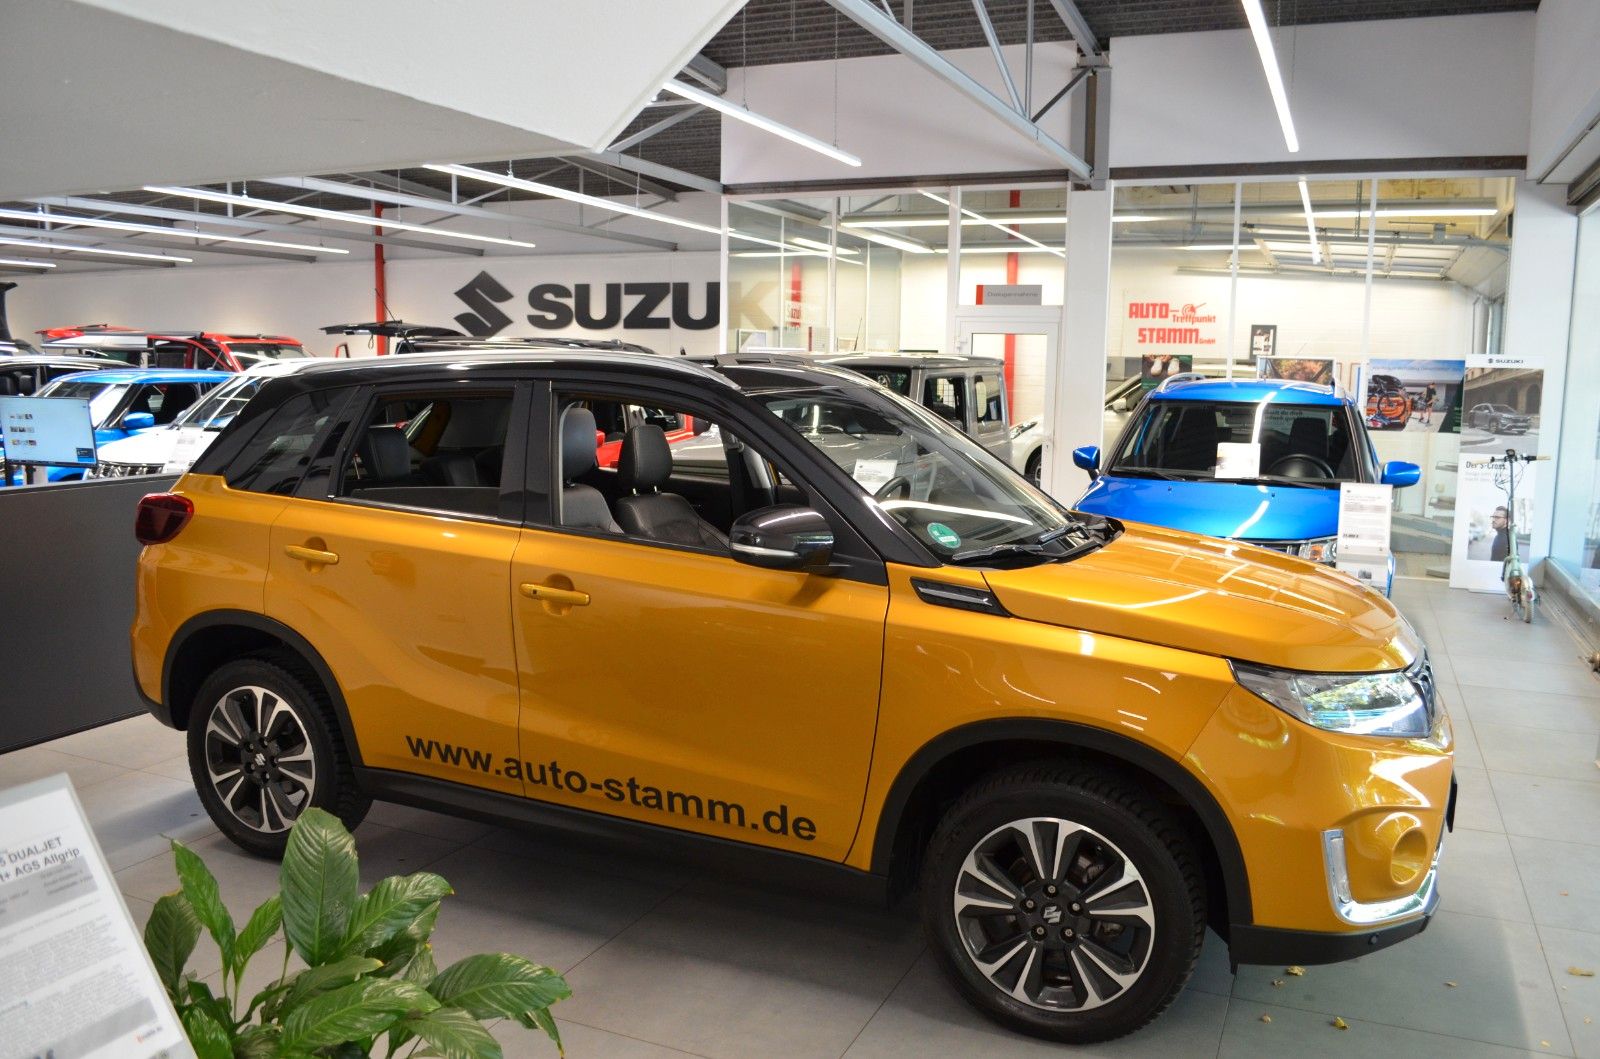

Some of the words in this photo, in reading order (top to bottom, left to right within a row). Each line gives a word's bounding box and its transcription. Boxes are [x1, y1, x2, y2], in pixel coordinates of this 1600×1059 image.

[1172, 314, 1216, 325] Treffpunkt
[1137, 327, 1199, 344] STAMM
[405, 735, 817, 841] www.auto-stamm.de
[8, 836, 63, 863] DUALJET
[15, 860, 41, 877] AGS
[44, 848, 80, 867] Allgrip
